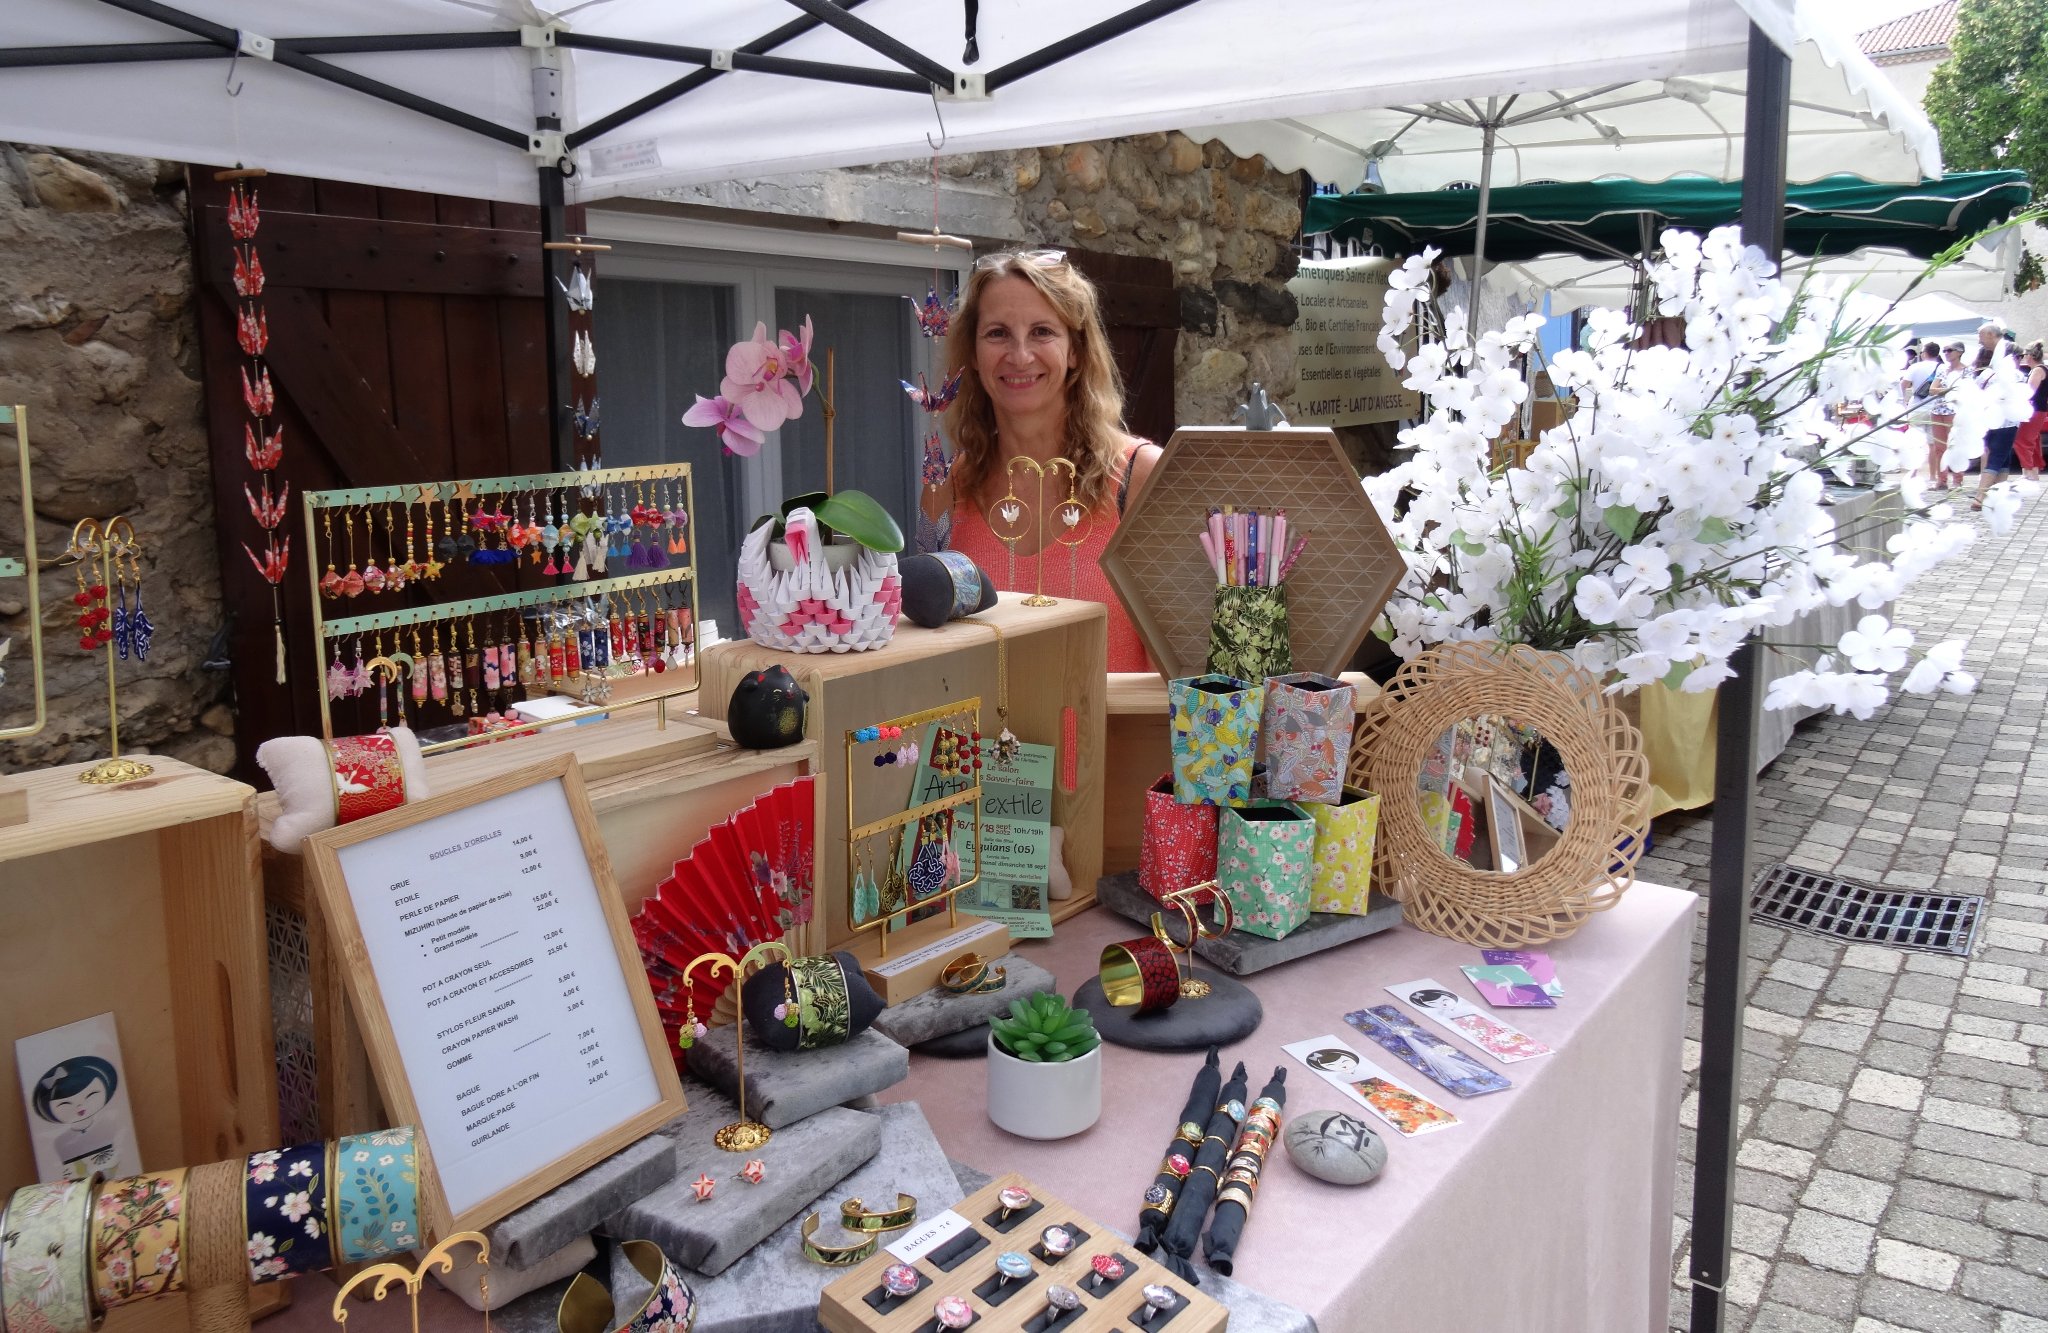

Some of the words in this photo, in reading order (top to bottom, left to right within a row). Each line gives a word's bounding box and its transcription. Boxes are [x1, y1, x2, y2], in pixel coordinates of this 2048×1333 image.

[1345, 267, 1366, 283] Sains
[1366, 272, 1374, 284] et
[1374, 270, 1389, 285] Nat
[1301, 293, 1326, 307] Locales
[1329, 297, 1335, 308] et
[1305, 318, 1318, 331] Bio
[1319, 320, 1327, 331] et
[1314, 343, 1324, 355] de
[1325, 343, 1376, 355] l'Environnement
[1301, 367, 1343, 381] Essentielles
[1344, 368, 1352, 379] et
[1352, 366, 1381, 381] Végétales
[1309, 395, 1341, 416] KARITÉ
[1349, 397, 1369, 413] LAIT
[986, 774, 1035, 786] Savoir-faire
[987, 763, 996, 771] Le
[981, 790, 1044, 816] extile
[429, 844, 462, 861] BOUCLES
[464, 829, 502, 849] D'OREILLES
[1013, 827, 1044, 836] 10h/19h
[1013, 843, 1035, 855] (05)
[390, 879, 410, 891] GRUE
[512, 835, 528, 846] 14,00
[394, 892, 420, 907] ETOILE
[519, 850, 533, 859] 9,00
[399, 908, 423, 922] PERLE
[424, 904, 434, 913] DE
[434, 894, 460, 908] PAPIER
[521, 864, 537, 875] 12,00
[404, 920, 435, 937] MIZUHIKI
[435, 911, 458, 927] (bande
[459, 906, 468, 916] de
[468, 899, 488, 915] papier
[488, 895, 497, 904] de
[497, 890, 513, 901] soie)
[431, 932, 447, 945] Petit
[447, 924, 471, 939] modèle
[532, 892, 548, 903] 15,00
[434, 941, 454, 954] Grand
[455, 931, 478, 946] modèle
[536, 900, 552, 911] 22,00
[422, 982, 437, 993] POT
[438, 979, 444, 987] A
[444, 967, 473, 984] CRAYON
[474, 959, 492, 971] SEUL
[543, 929, 559, 941] 12,00
[427, 998, 442, 1009] POT
[449, 982, 478, 1000] CRAYON
[478, 977, 488, 986] ET
[489, 957, 534, 981] ACCESSOIRES
[547, 944, 563, 956] 23,50
[436, 1022, 464, 1039] STYLOS
[465, 1011, 487, 1027] FLEUR
[487, 999, 516, 1016] SAKURA
[441, 1037, 471, 1055] CRAYON
[472, 1025, 496, 1041] PAPIER
[497, 1014, 519, 1029] WASHI
[563, 988, 575, 998] 4,00
[446, 1053, 473, 1070] GOMME
[567, 1002, 580, 1012] 3,00
[456, 1084, 481, 1101] BAGUE
[577, 1030, 590, 1040] 7,00
[461, 1100, 485, 1117] BAGUE
[486, 1090, 505, 1104] DORE
[506, 1086, 512, 1094] A
[529, 1072, 540, 1082] FIN
[579, 1044, 594, 1056] 12,00
[466, 1101, 516, 1133] MARQUE-PAGE
[586, 1058, 599, 1069] 7,00
[471, 1122, 510, 1148] GUIRLANDE
[588, 1073, 604, 1085] 24,00
[903, 1229, 937, 1252] BAGUES
